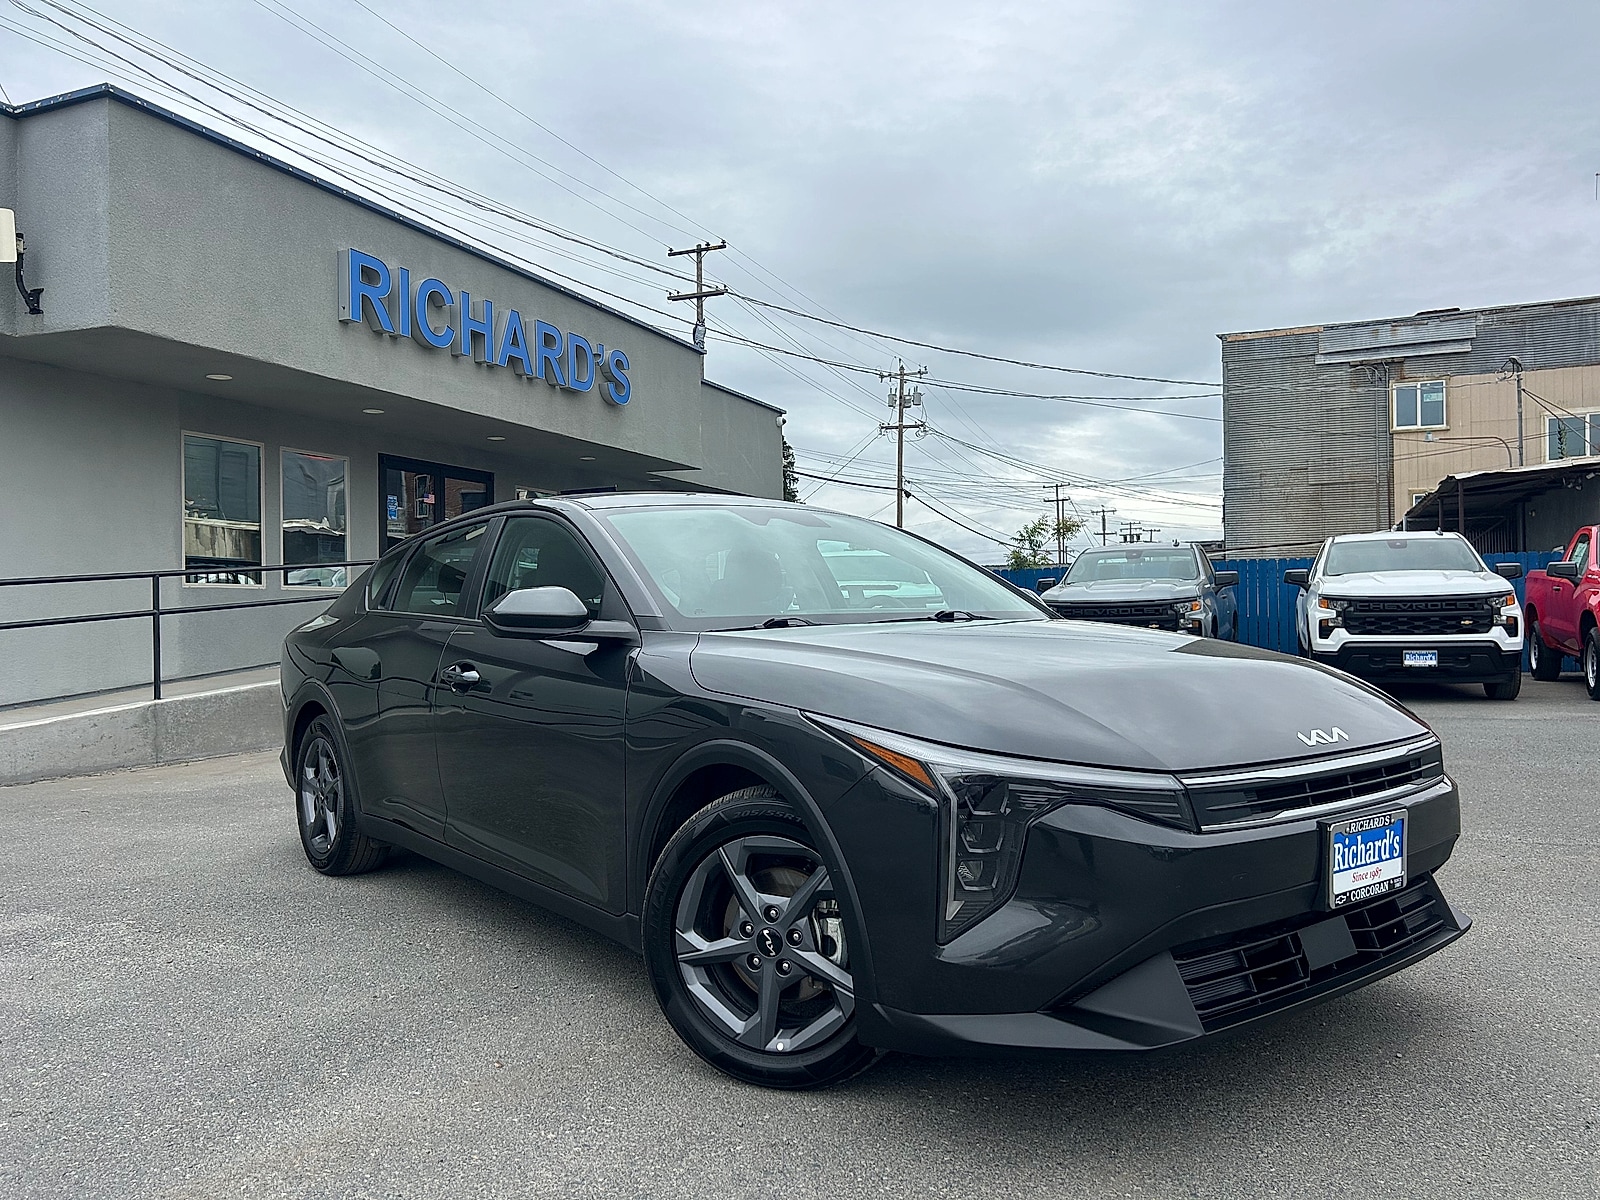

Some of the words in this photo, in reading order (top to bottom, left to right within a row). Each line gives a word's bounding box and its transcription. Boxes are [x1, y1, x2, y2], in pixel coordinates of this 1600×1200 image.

[346, 247, 632, 406] RICHARD'S
[1062, 606, 1168, 617] CHEVROLET
[1355, 601, 1483, 611] CHEVROLET
[1333, 829, 1400, 871] Richard's
[1352, 871, 1369, 883] Since
[1369, 867, 1382, 880] 1987
[1350, 881, 1389, 901] CORCORAN
